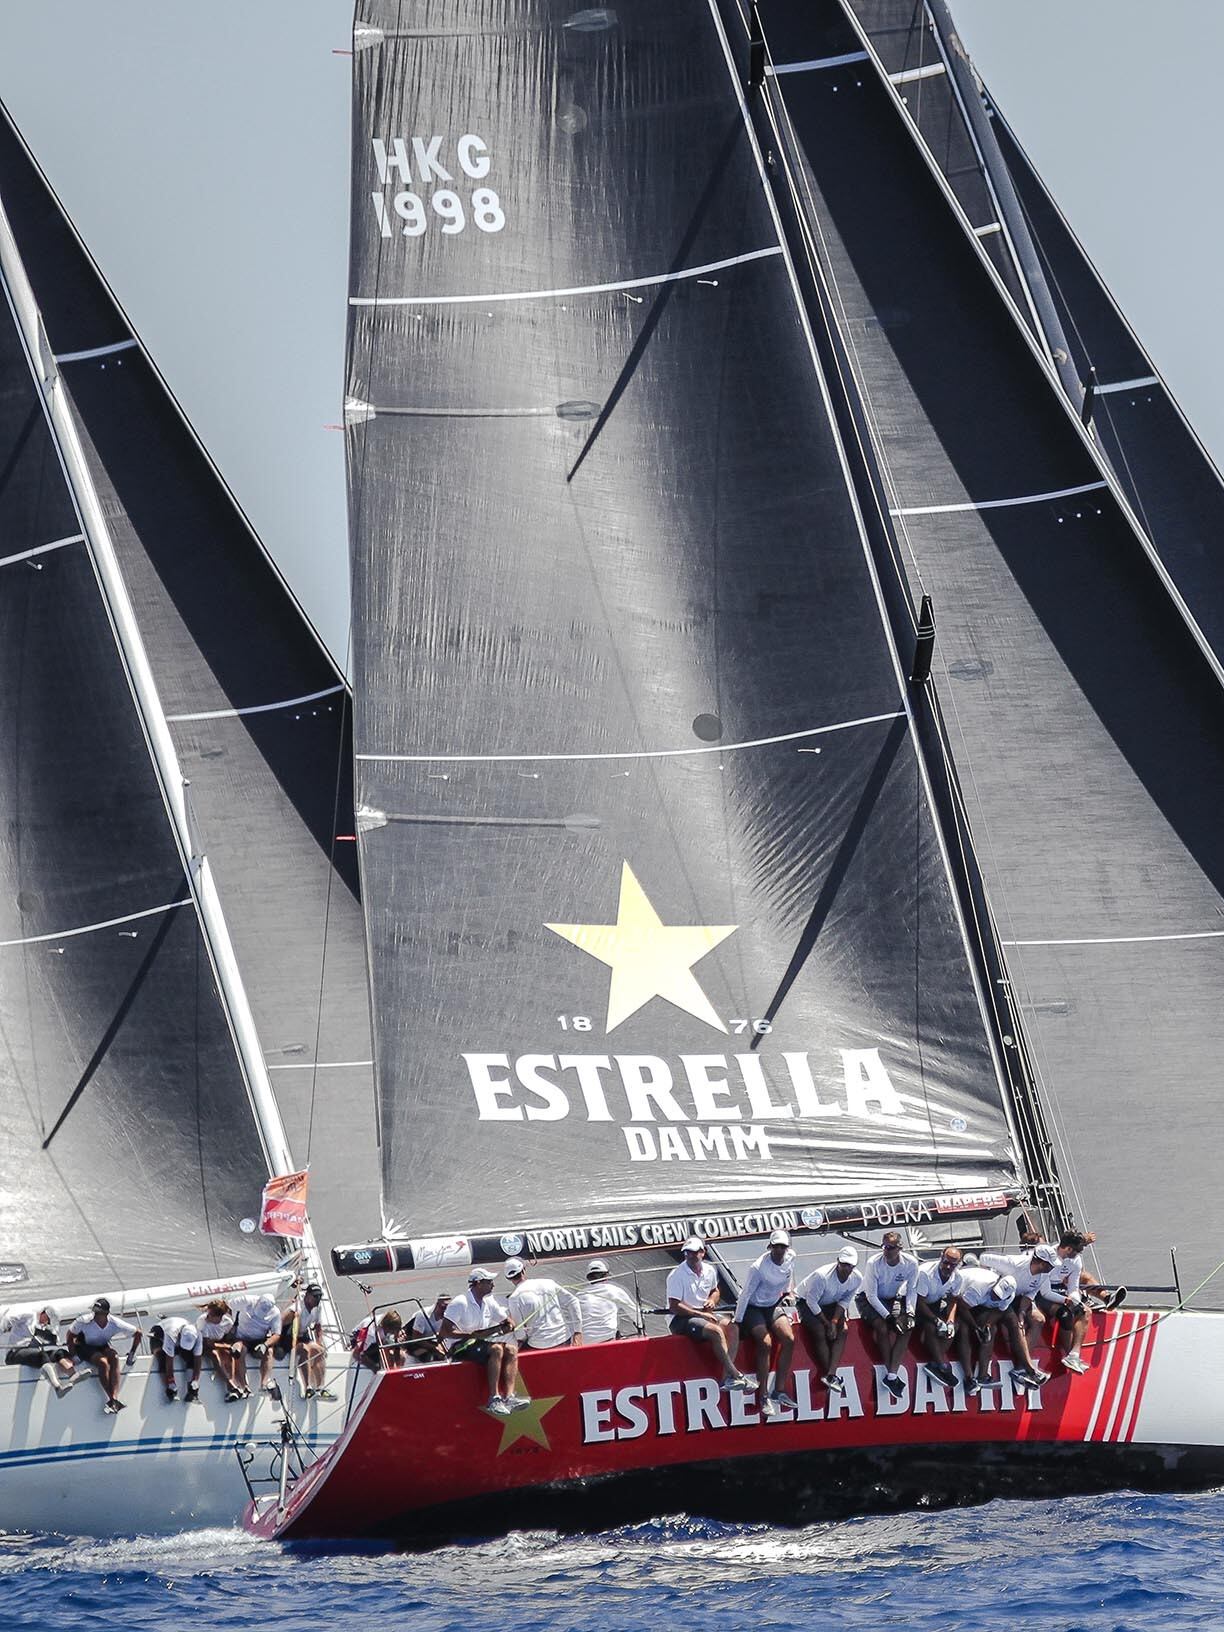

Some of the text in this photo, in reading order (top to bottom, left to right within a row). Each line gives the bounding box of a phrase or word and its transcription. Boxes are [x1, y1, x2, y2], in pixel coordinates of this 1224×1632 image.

[372, 134, 490, 184] HKG
[372, 188, 505, 237] 1998
[557, 1016, 773, 1034] 18 76
[461, 1047, 904, 1121] ESTRELLA
[621, 1125, 773, 1161] DAMM
[526, 1211, 798, 1253] NORTH SAILS CREW COLLECTION
[860, 1200, 932, 1227] POLKA
[580, 1366, 864, 1443] ESTRELLA
